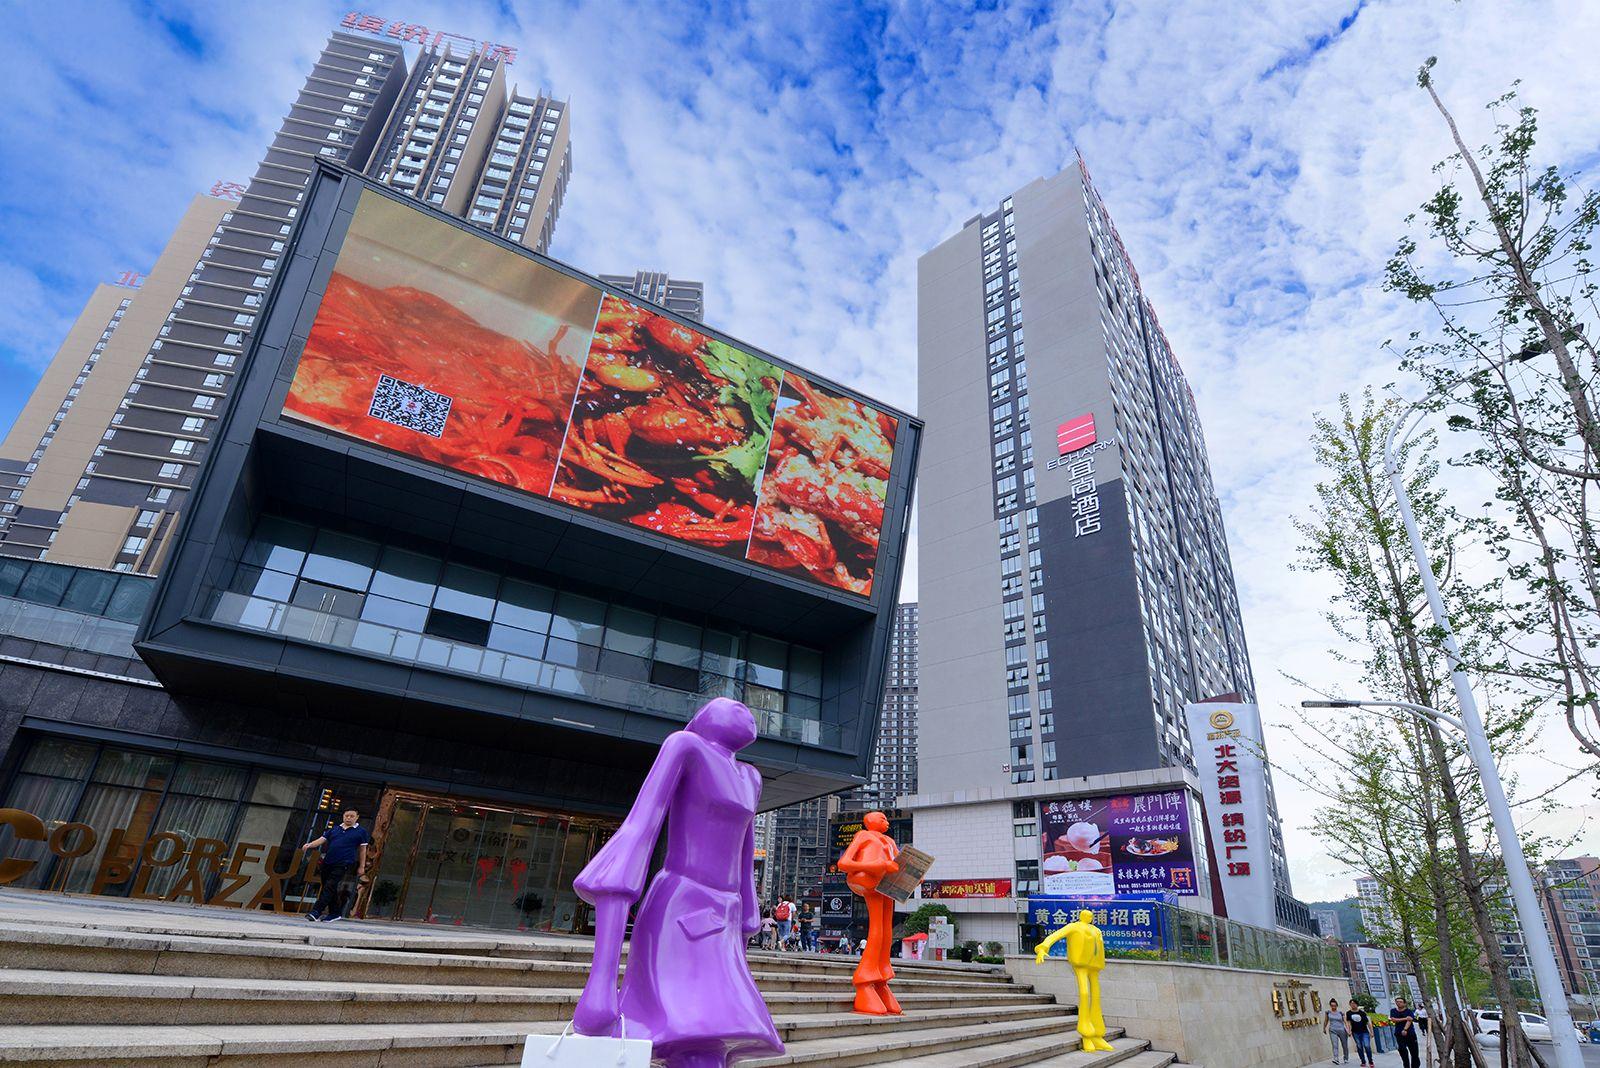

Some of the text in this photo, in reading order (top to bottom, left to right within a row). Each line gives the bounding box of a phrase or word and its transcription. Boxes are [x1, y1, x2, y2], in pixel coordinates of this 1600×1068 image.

[1046, 437, 1116, 471] ECHARM
[1067, 456, 1102, 538] 宜尚酒店
[1214, 744, 1250, 877] 北大资源 缤纷广场
[94, 857, 285, 914] PLAZA
[1117, 866, 1166, 880] 承接各种宴席
[1102, 929, 1153, 939] 3608559413
